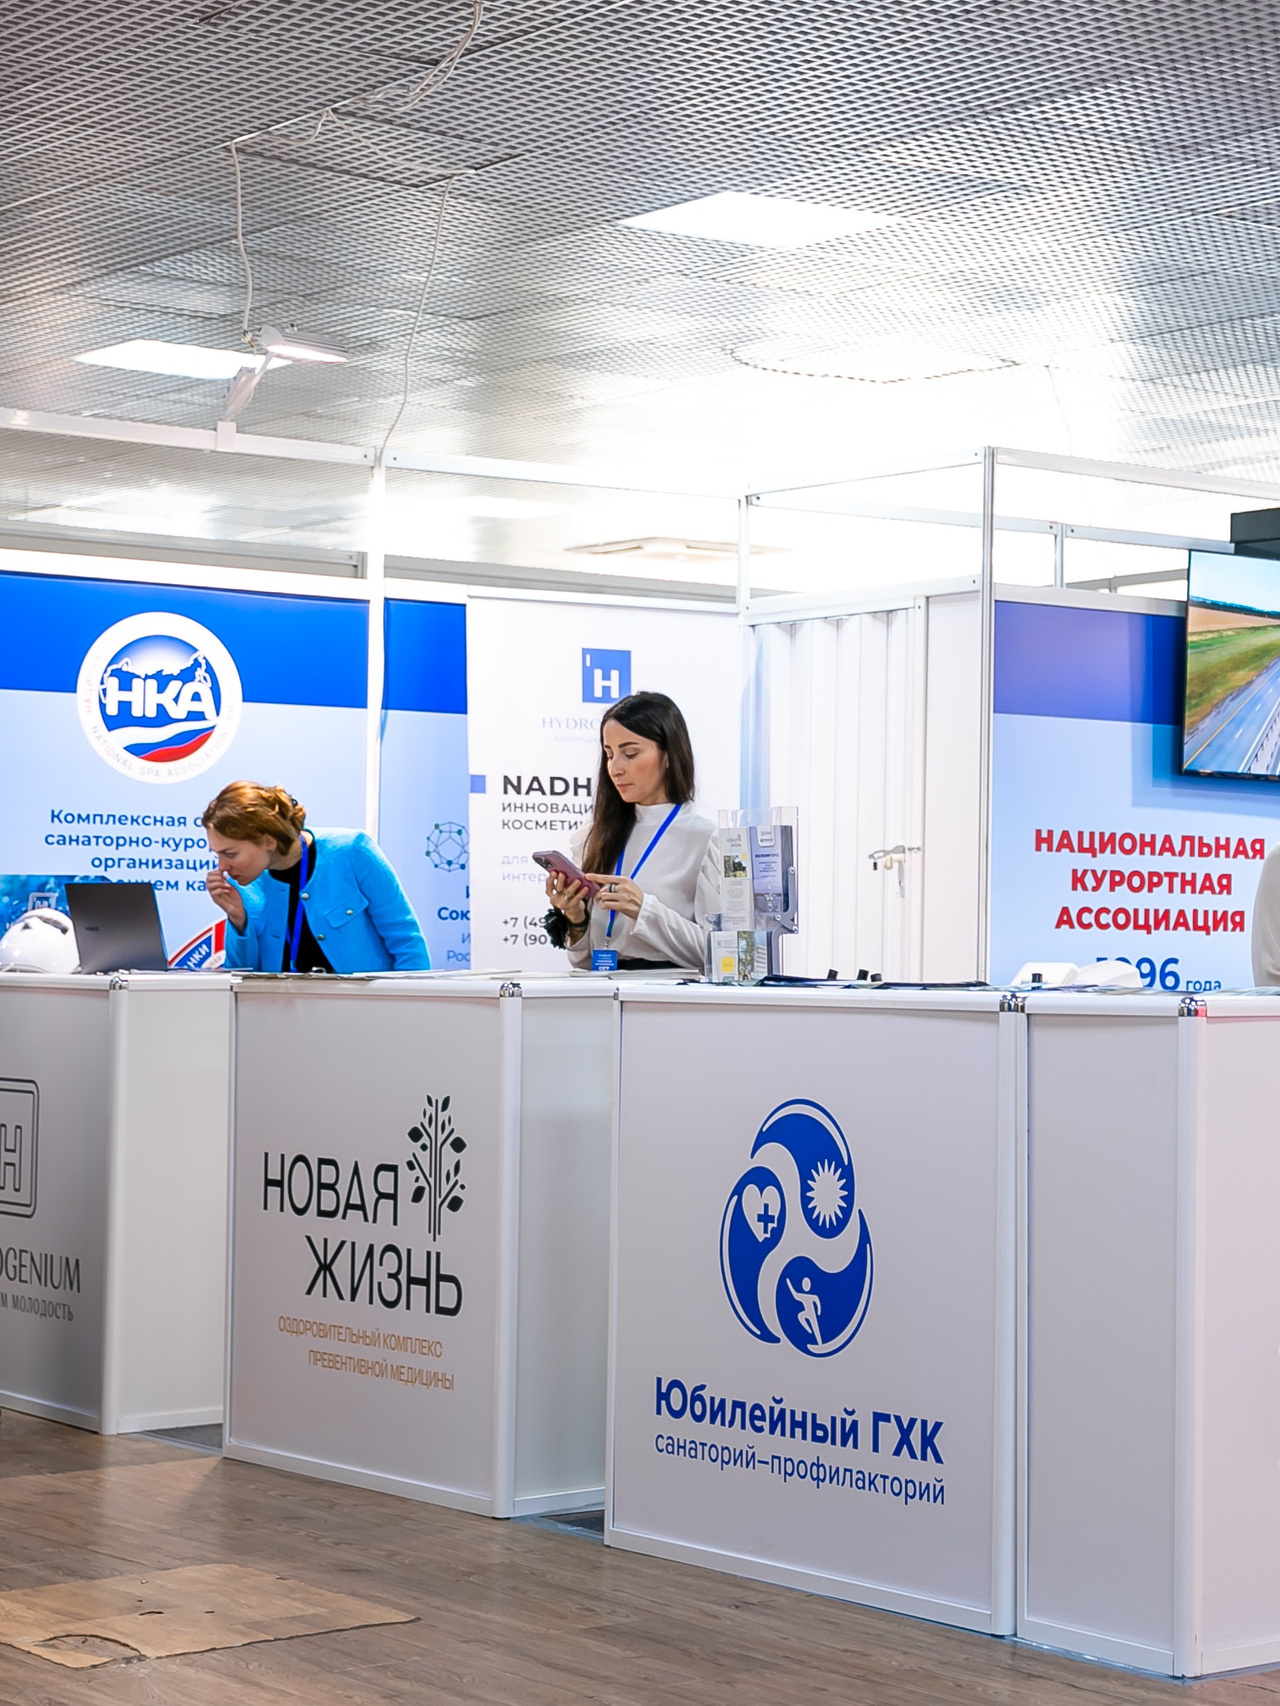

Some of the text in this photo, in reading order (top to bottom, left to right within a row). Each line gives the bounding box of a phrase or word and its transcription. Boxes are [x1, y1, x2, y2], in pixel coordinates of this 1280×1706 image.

[139, 765, 161, 778] SPA
[502, 774, 593, 797] NADH
[50, 809, 187, 828] Комплексная
[501, 819, 583, 831] КОСМЕТИ
[44, 833, 212, 852] санаторно-куро
[1034, 829, 1266, 860] НАЦИОНАЛЬНАЯ
[501, 855, 528, 866] для
[1071, 868, 1232, 896] КУРОРТНАЯ
[502, 916, 519, 928] +7
[1054, 906, 1246, 936] АССОЦИАЦИЯ
[502, 933, 519, 946] +7
[1095, 957, 1181, 991] 96
[263, 1151, 399, 1227] НОВАЯ
[304, 1234, 463, 1317] ЖИЗНЬ
[12, 1293, 74, 1322] МОЛОДОСТЬ
[277, 1315, 443, 1359] ОЗДОРОВИТЕЛЬНЫЙ КОМПЛЕКС
[308, 1349, 455, 1391] ПРЕВЕНТИВНОЙ МЕДИЦИНЫ
[655, 1376, 945, 1465] Юбилейный ГХК
